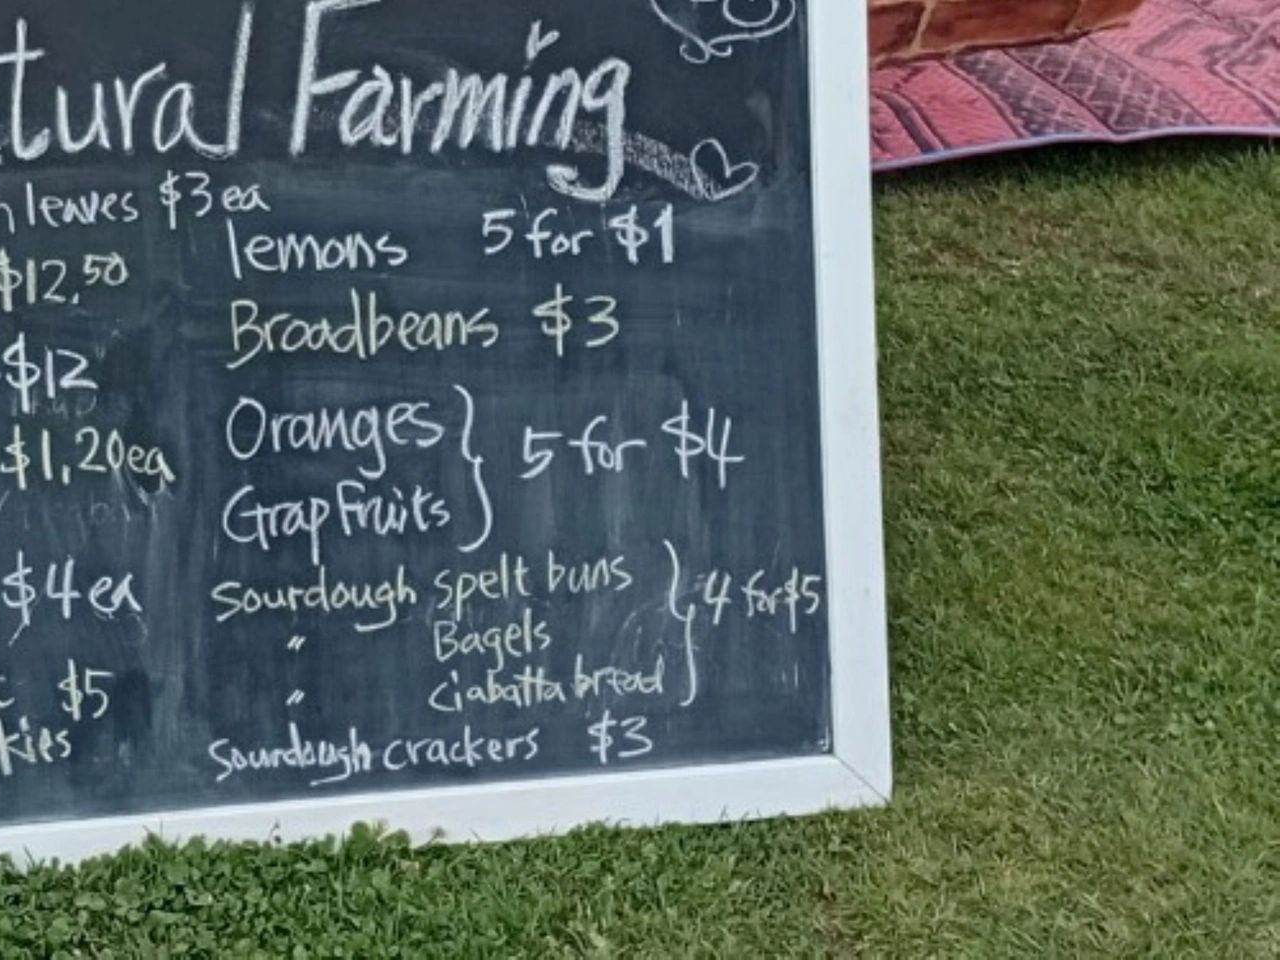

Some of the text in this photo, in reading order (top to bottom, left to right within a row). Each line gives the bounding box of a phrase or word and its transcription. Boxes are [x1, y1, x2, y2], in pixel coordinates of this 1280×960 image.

[25, 180, 140, 229] leaves
[482, 208, 516, 255] 5
[525, 207, 594, 259] for
[608, 202, 675, 265] $1
[225, 281, 620, 370] Broadbeans $3
[1, 331, 99, 416] $12
[225, 395, 746, 490] Oranges 5 for $4
[547, 549, 635, 596] buns
[702, 569, 732, 626] 4
[431, 607, 552, 672] Bagels
[58, 657, 116, 723] $5
[573, 651, 665, 700] bread
[381, 723, 542, 771] crackers
[587, 709, 655, 765] $3
